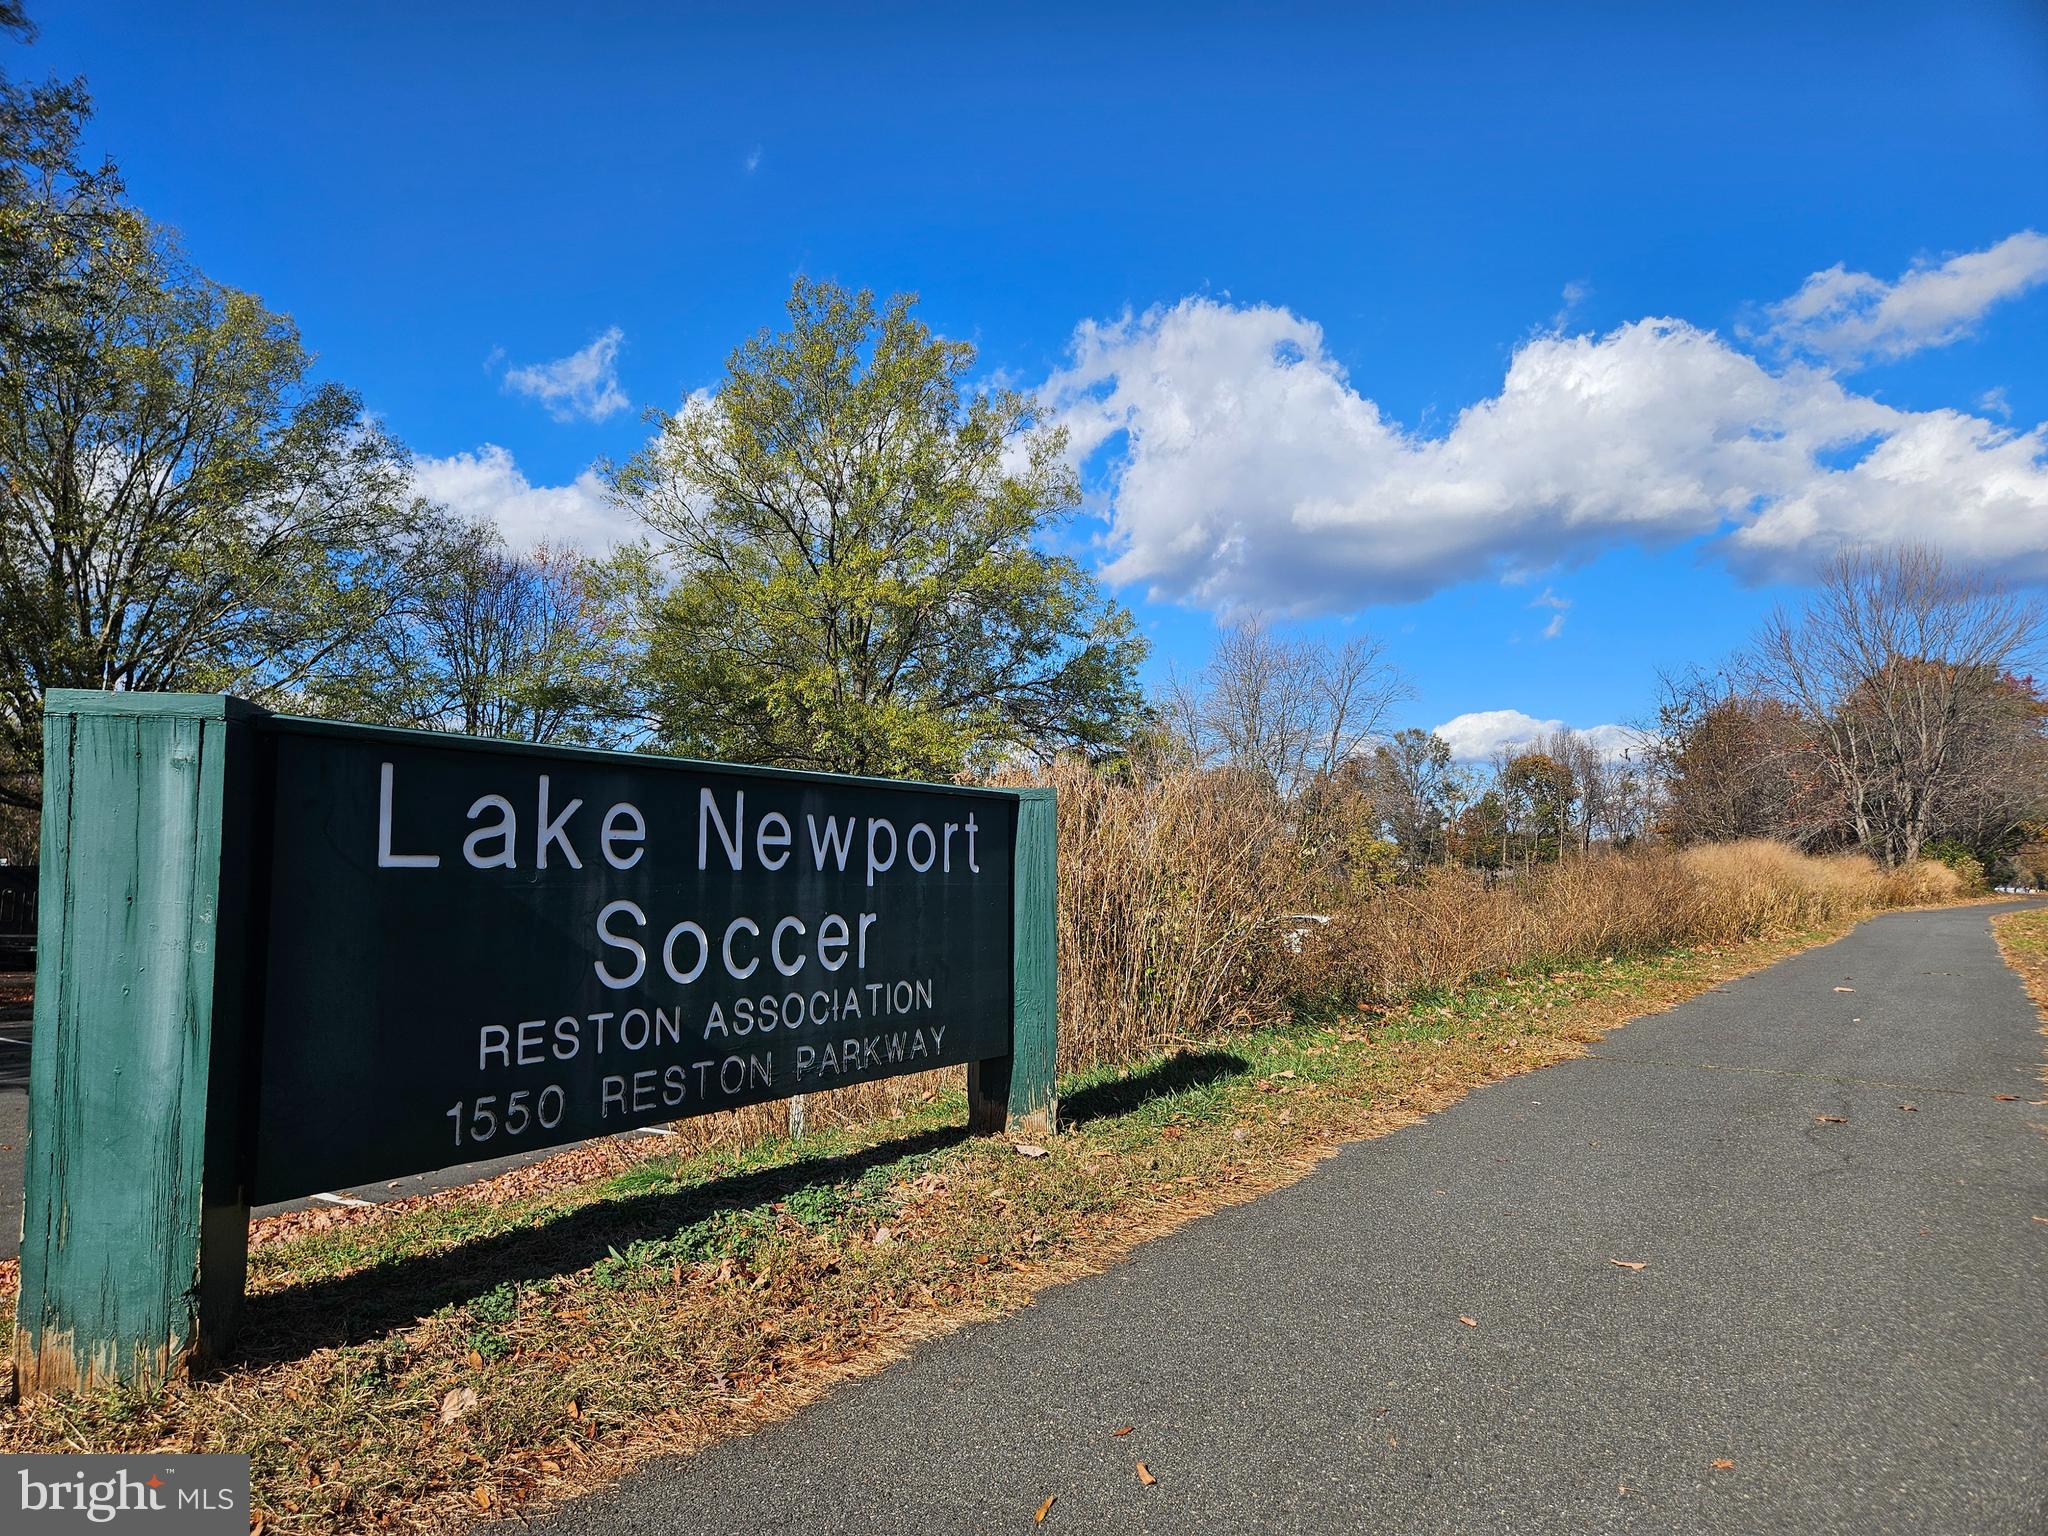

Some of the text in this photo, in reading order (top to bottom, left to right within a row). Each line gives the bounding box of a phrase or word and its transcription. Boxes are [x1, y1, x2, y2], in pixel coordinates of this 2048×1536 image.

[378, 762, 981, 887] Lake Newport
[594, 899, 877, 989] Soccer
[479, 978, 934, 1070] RESTON ASSOCIATION
[446, 1025, 947, 1146] 1550 RESTON PARKWAY
